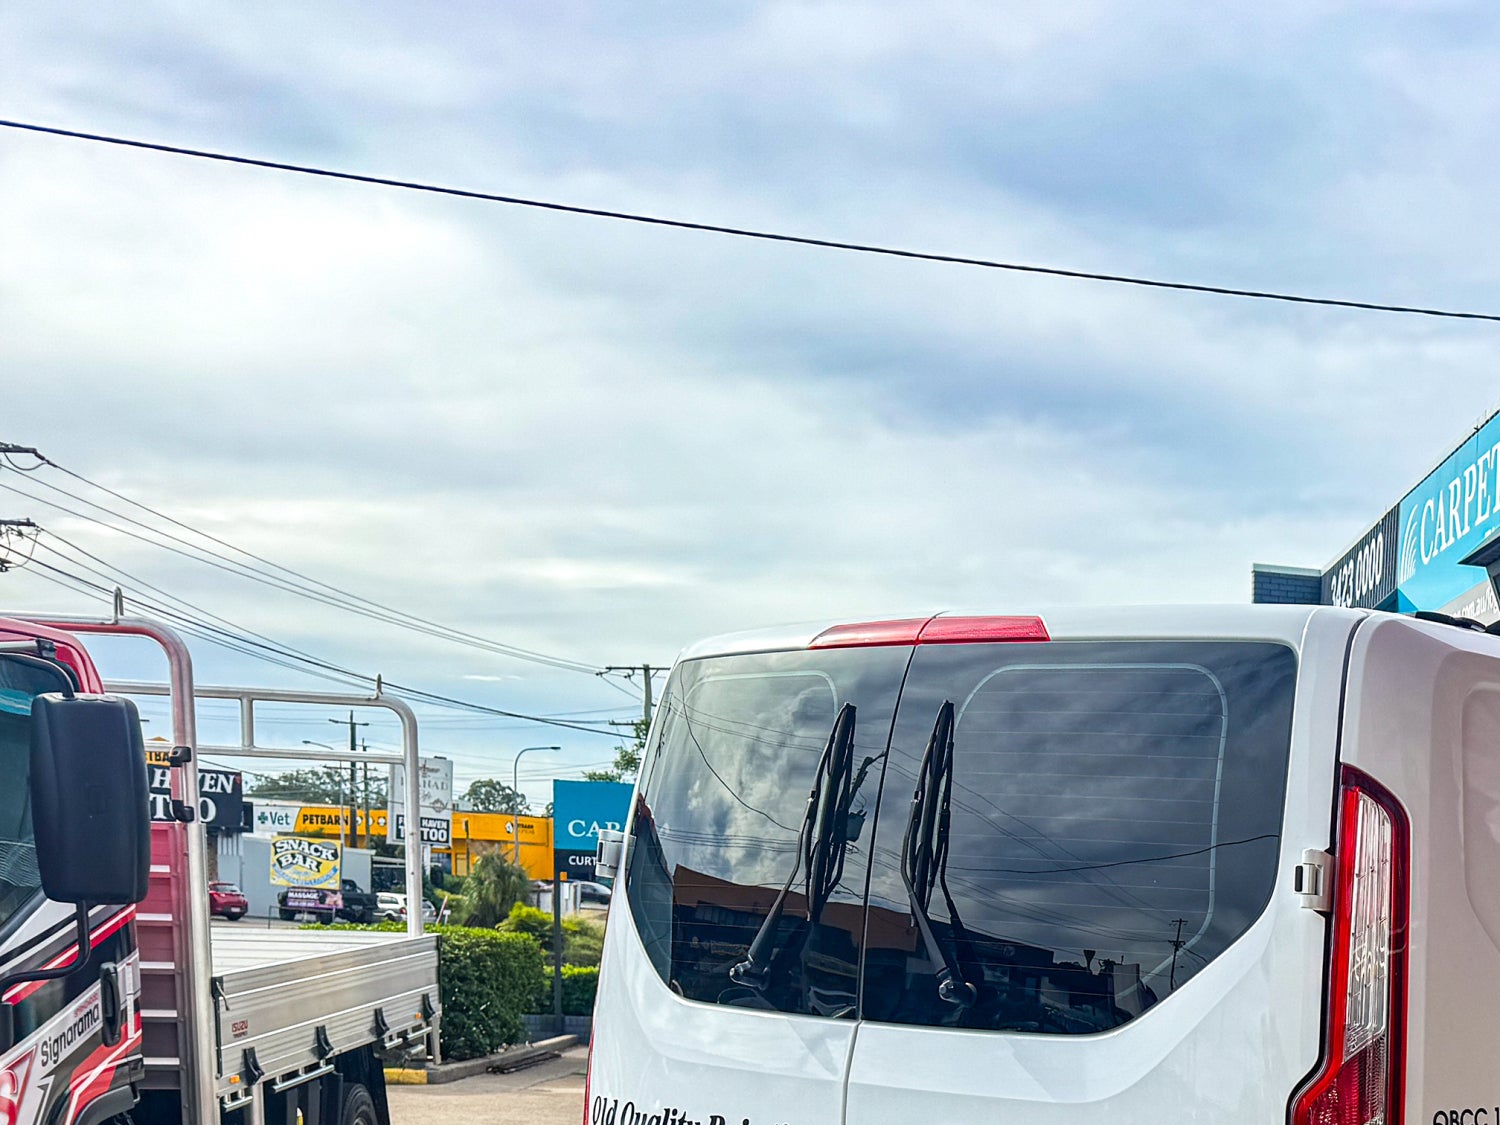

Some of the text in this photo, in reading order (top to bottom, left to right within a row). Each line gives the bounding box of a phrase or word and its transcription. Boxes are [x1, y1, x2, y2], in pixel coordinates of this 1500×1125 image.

[1355, 532, 1384, 601] 0000
[270, 812, 290, 825] Vet
[302, 814, 349, 826] PETBARN
[421, 819, 448, 829] HAVEN
[275, 839, 336, 861] SNACK
[278, 853, 319, 873] BAR
[41, 1003, 100, 1067] Signarama
